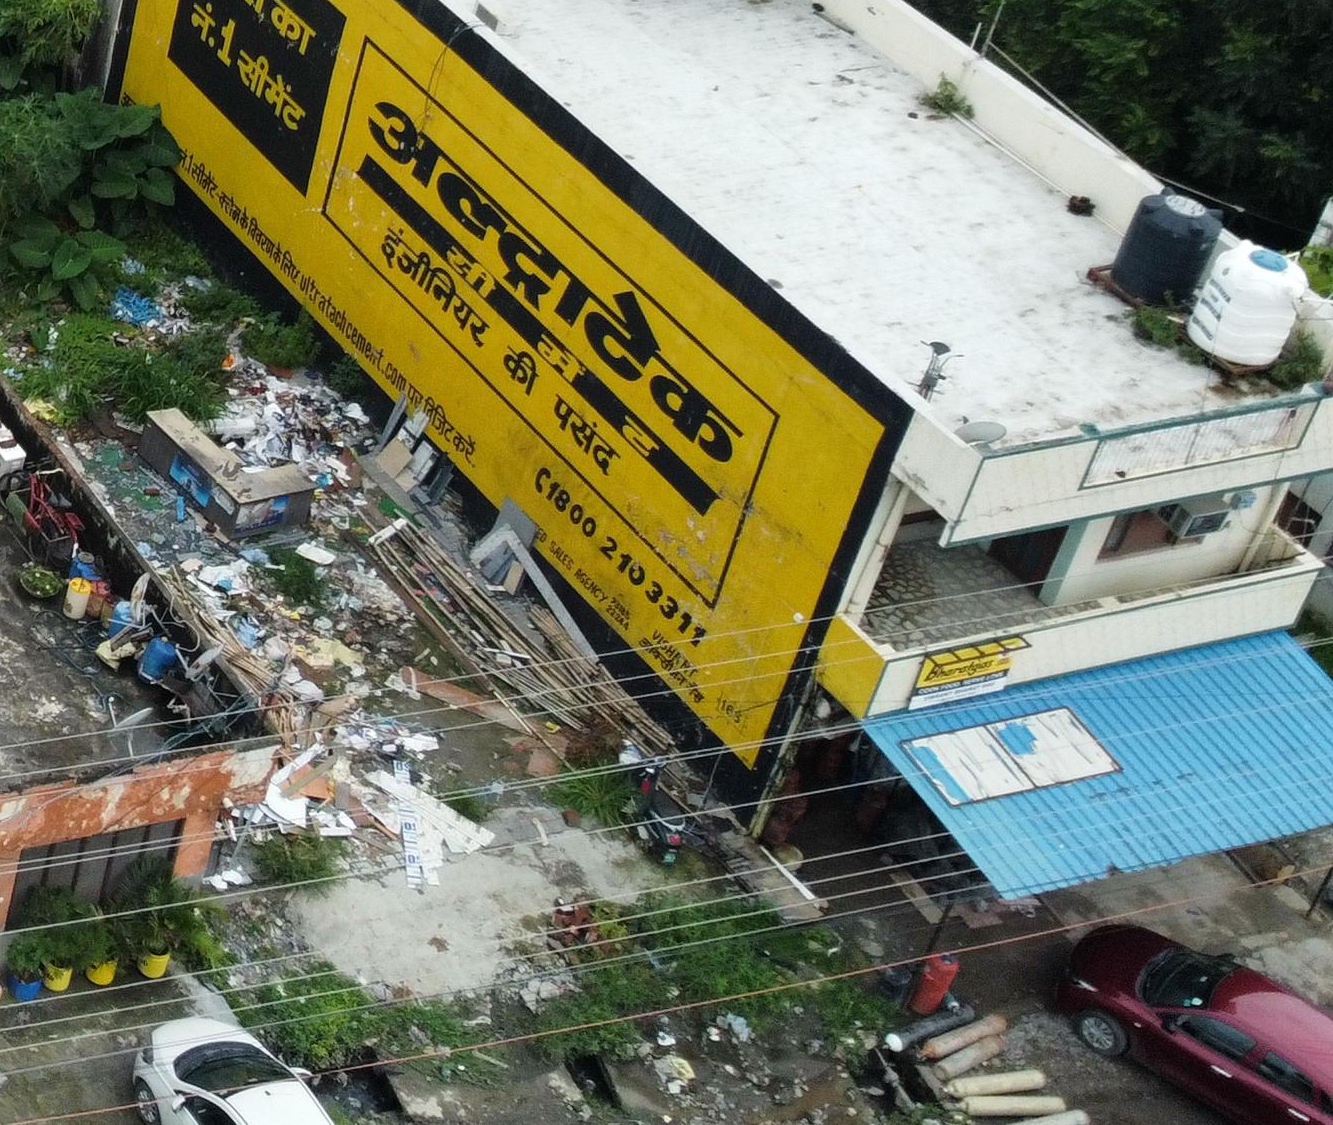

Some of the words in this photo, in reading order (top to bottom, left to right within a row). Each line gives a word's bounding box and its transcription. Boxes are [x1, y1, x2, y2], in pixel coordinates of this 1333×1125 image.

[237, 49, 307, 131] सीमेंट
[368, 101, 744, 463] अल्ट्राटेक
[381, 228, 490, 347] इंजीनियर
[502, 344, 539, 396] की
[554, 393, 621, 475] पसंद
[549, 540, 574, 571] SALES
[574, 568, 608, 603] AGENCY
[599, 536, 646, 586] 210
[644, 580, 708, 647] 3311
